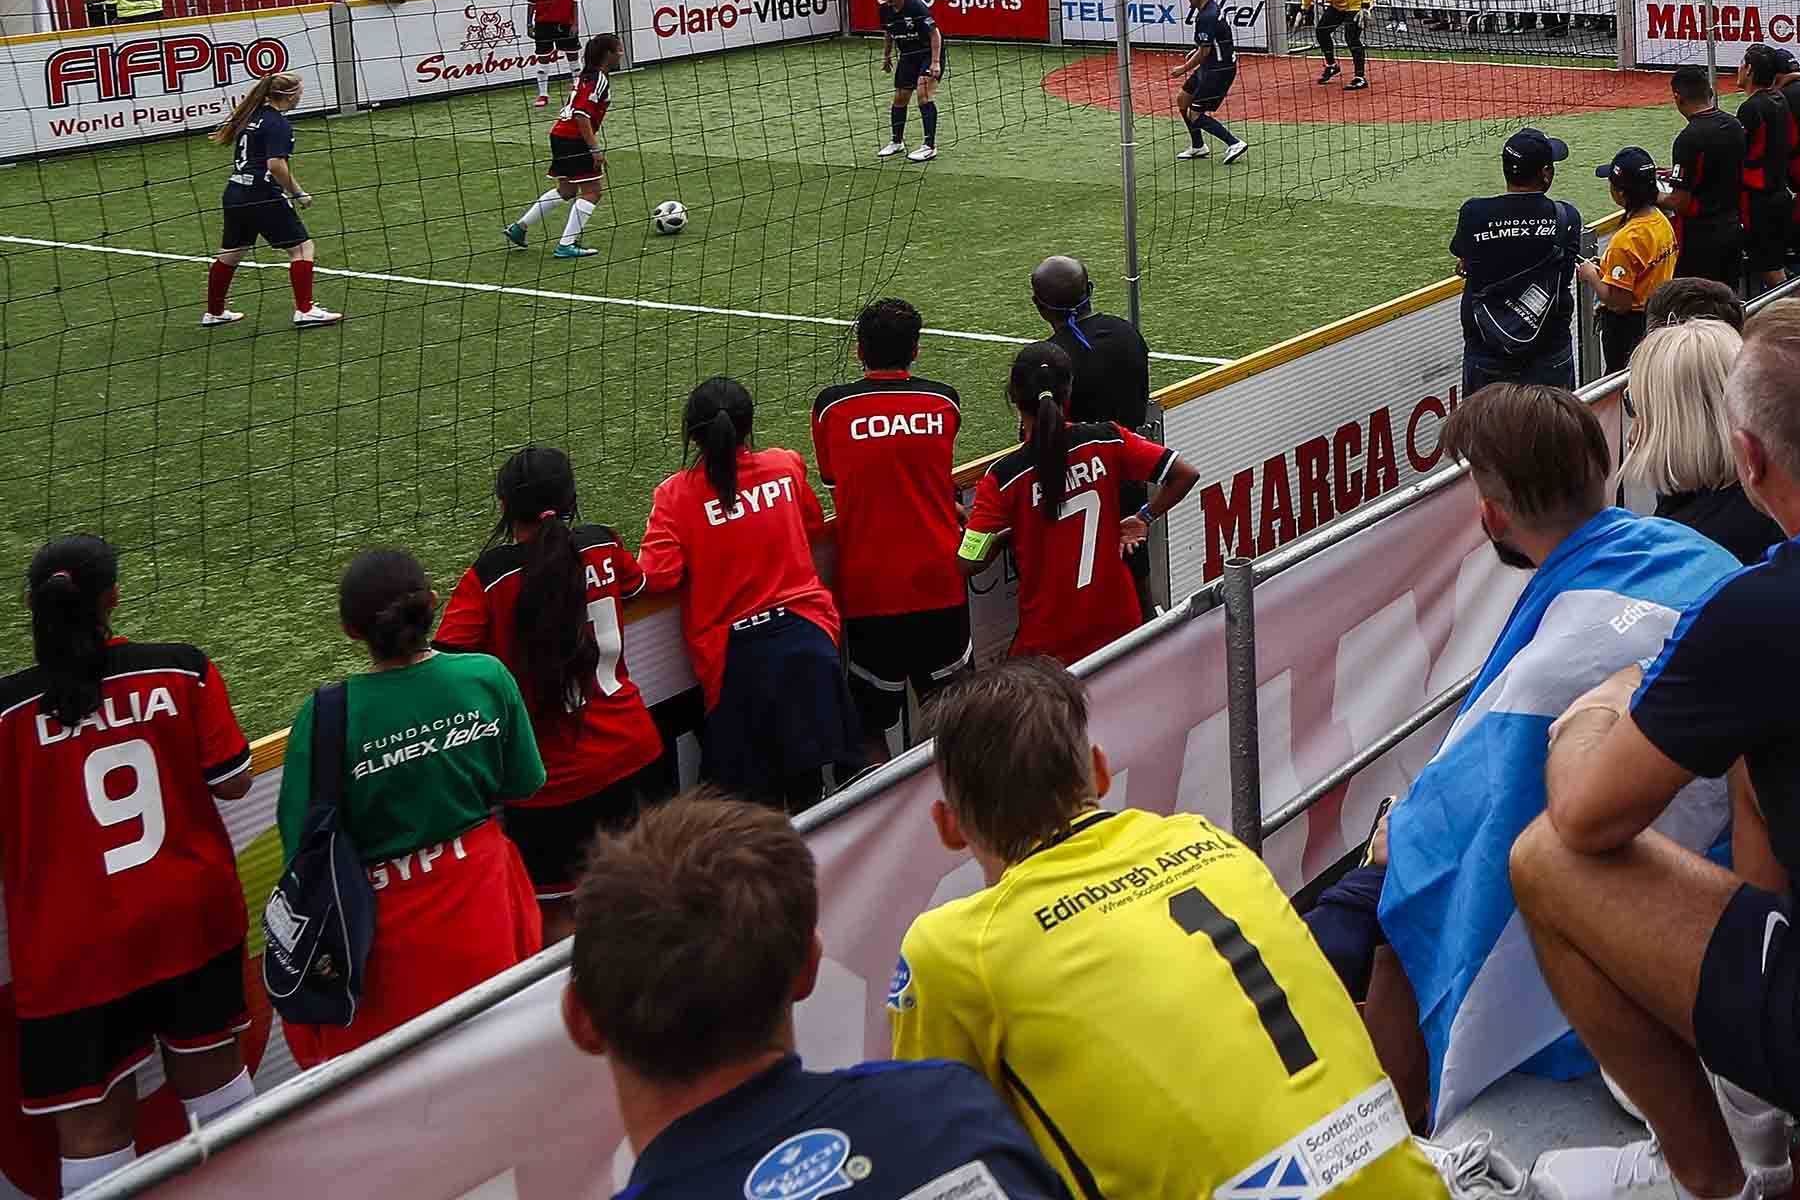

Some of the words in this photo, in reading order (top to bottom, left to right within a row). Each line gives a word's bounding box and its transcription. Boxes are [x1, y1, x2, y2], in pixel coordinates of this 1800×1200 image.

[46, 33, 289, 109] FIFPro
[50, 112, 124, 137] World
[1474, 227, 1530, 243] TELMEX
[850, 413, 943, 440] COACH
[703, 475, 793, 527] EGYPT
[1200, 405, 1400, 584] MARCA
[1057, 490, 1101, 589] 7
[36, 687, 178, 746] DALIA
[362, 710, 480, 753] FUNDACIÓN
[352, 738, 438, 780] ELMEX
[84, 739, 166, 876] 9
[1033, 866, 1158, 932] Edinburgh
[1099, 895, 1134, 915] Where
[1133, 877, 1174, 900] Scotland
[1169, 886, 1320, 1077] 1
[1306, 1110, 1357, 1153] Scottish
[1321, 1140, 1372, 1185] gov.scot
